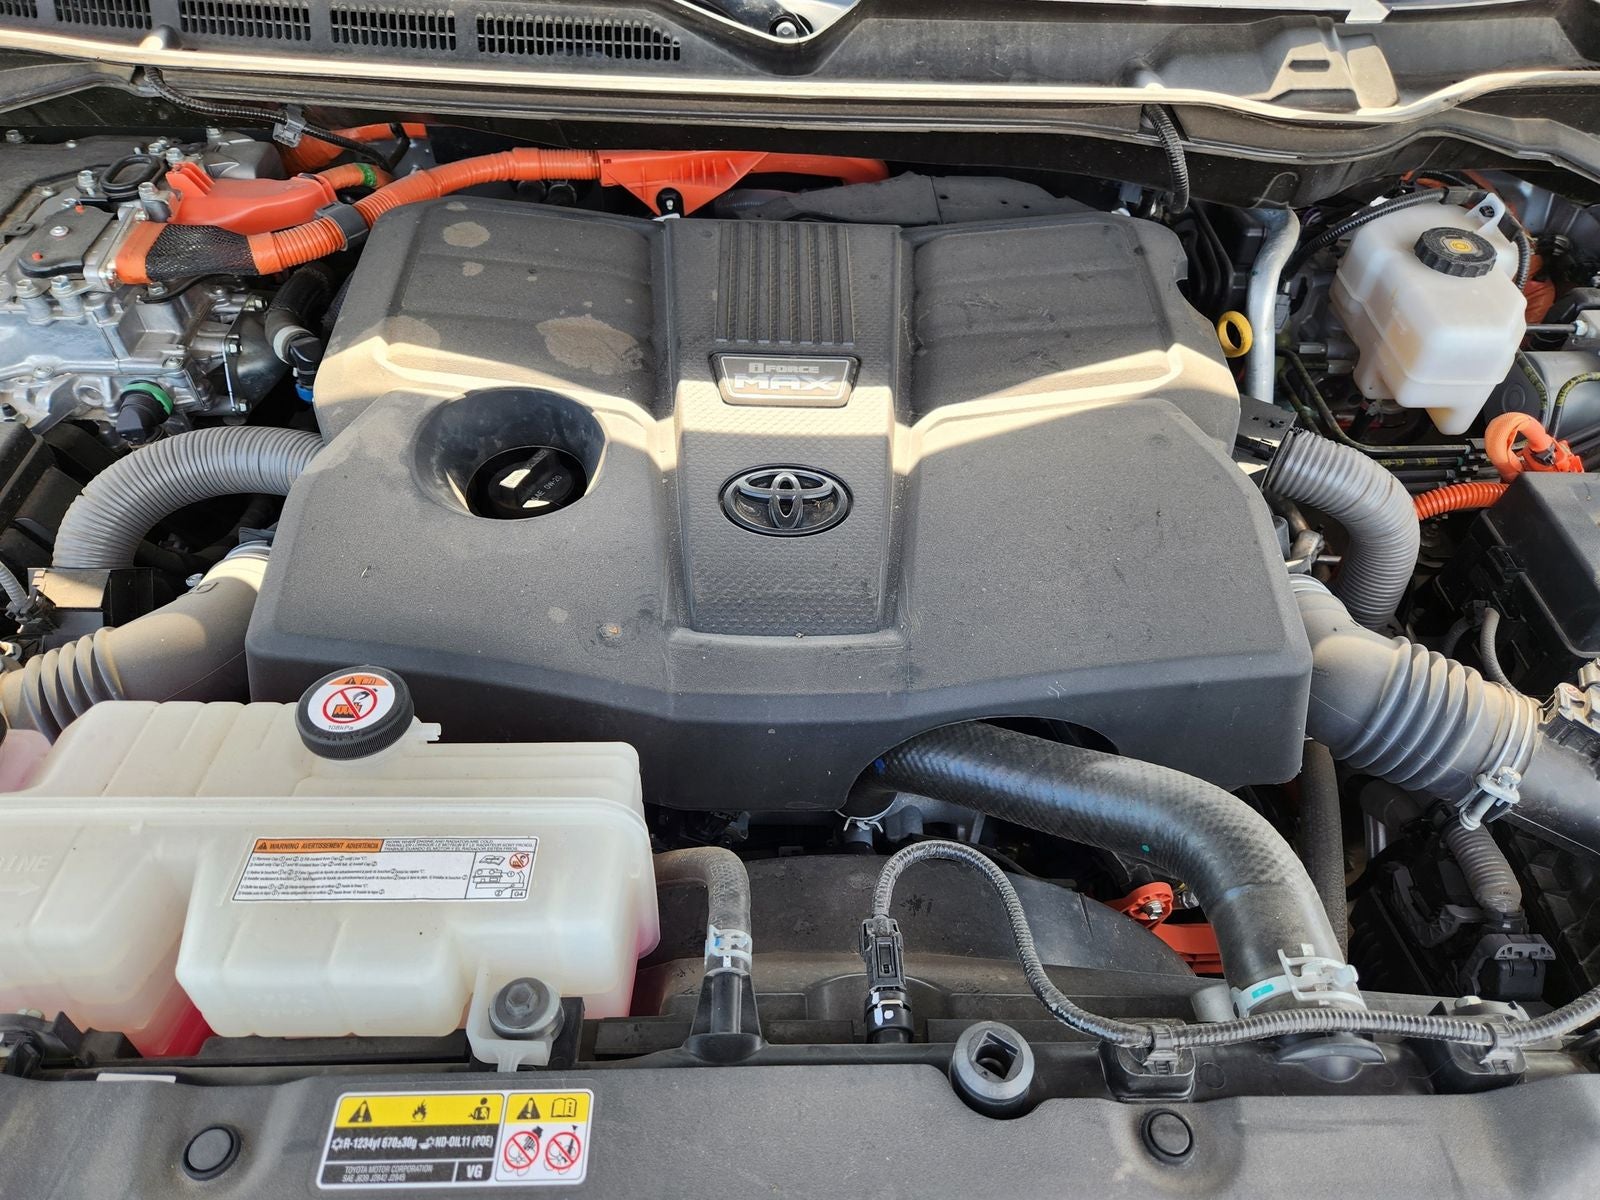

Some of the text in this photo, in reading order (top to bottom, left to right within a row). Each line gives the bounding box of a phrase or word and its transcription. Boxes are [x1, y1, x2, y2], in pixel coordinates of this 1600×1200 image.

[734, 373, 836, 390] MAX
[471, 1135, 494, 1149] (POE)
[344, 1164, 433, 1173] TOYOTA MOTOR CORPORATION
[466, 1164, 484, 1178] VG
[341, 1174, 354, 1183] SAE
